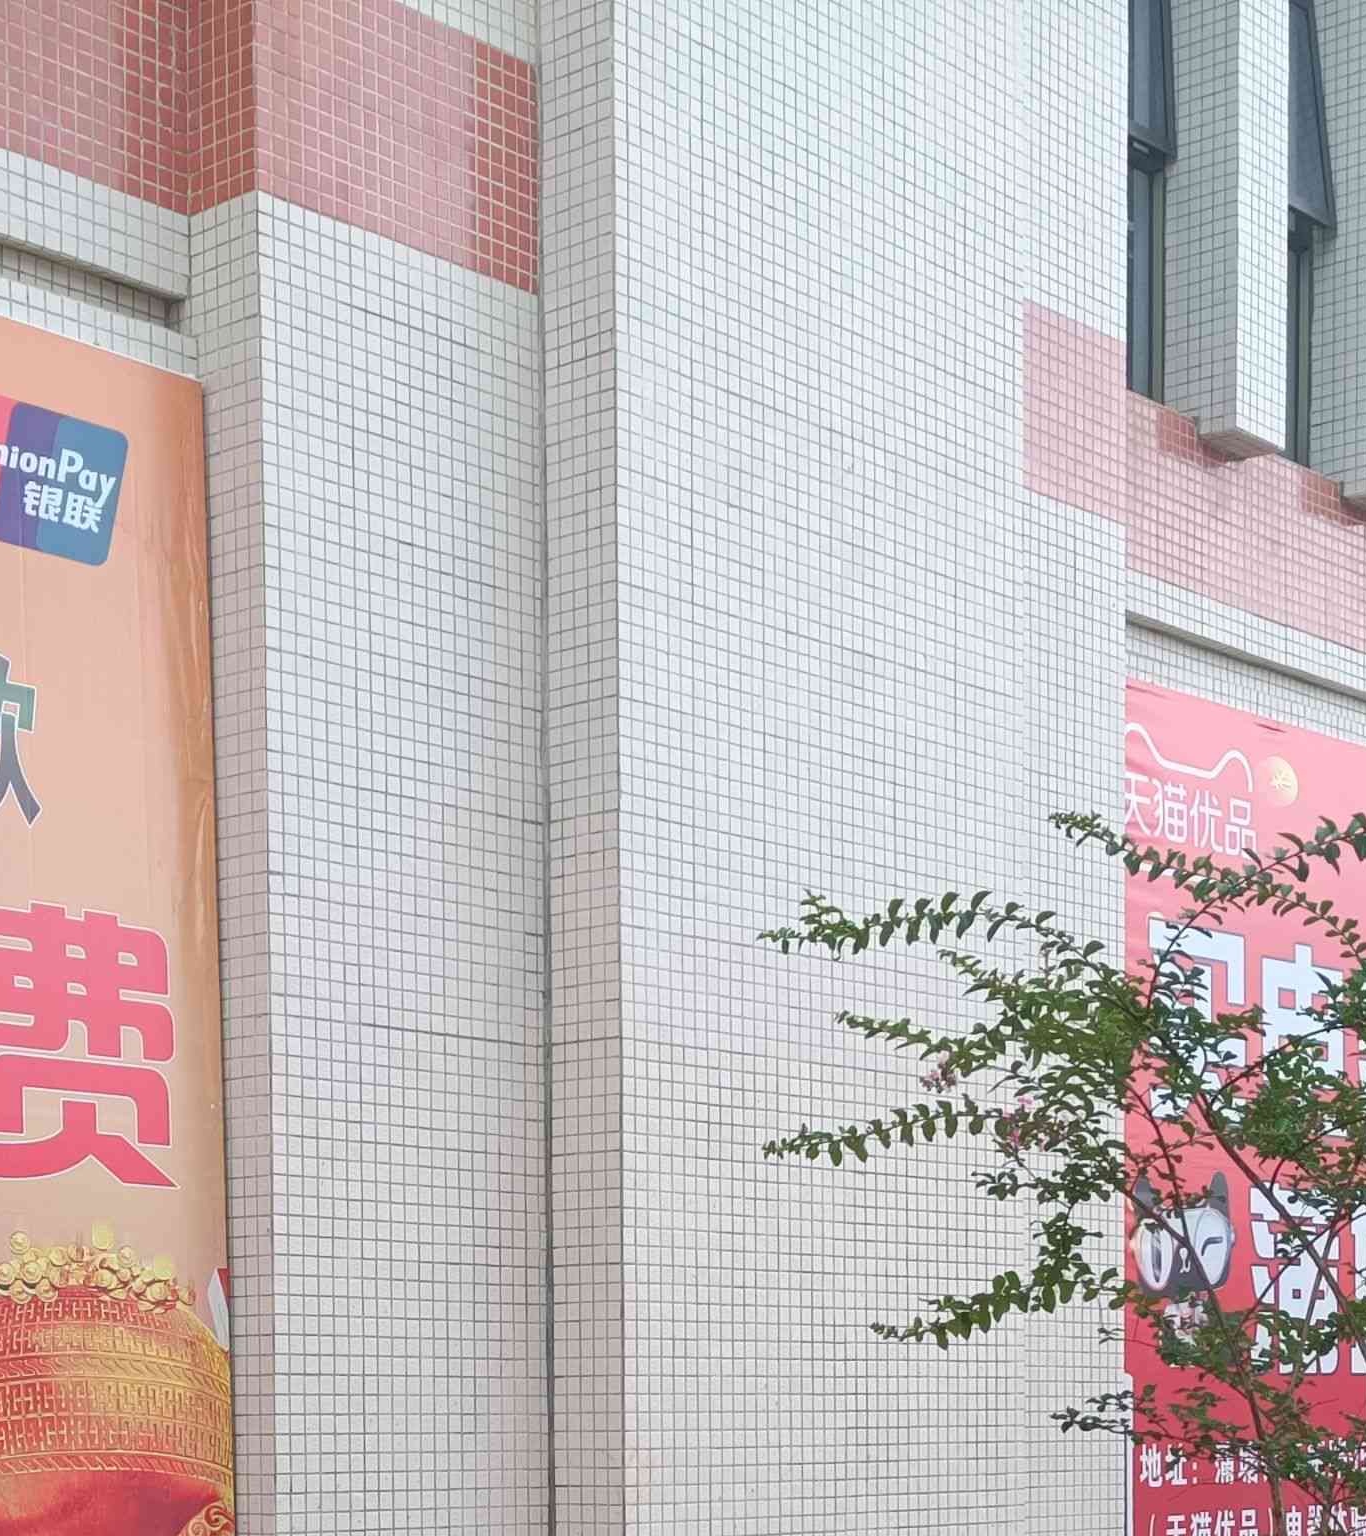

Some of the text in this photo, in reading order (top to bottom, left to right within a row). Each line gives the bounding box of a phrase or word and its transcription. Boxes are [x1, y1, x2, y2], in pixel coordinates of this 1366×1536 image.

[23, 481, 102, 533] 银联
[1124, 771, 1257, 861] 天猫优品
